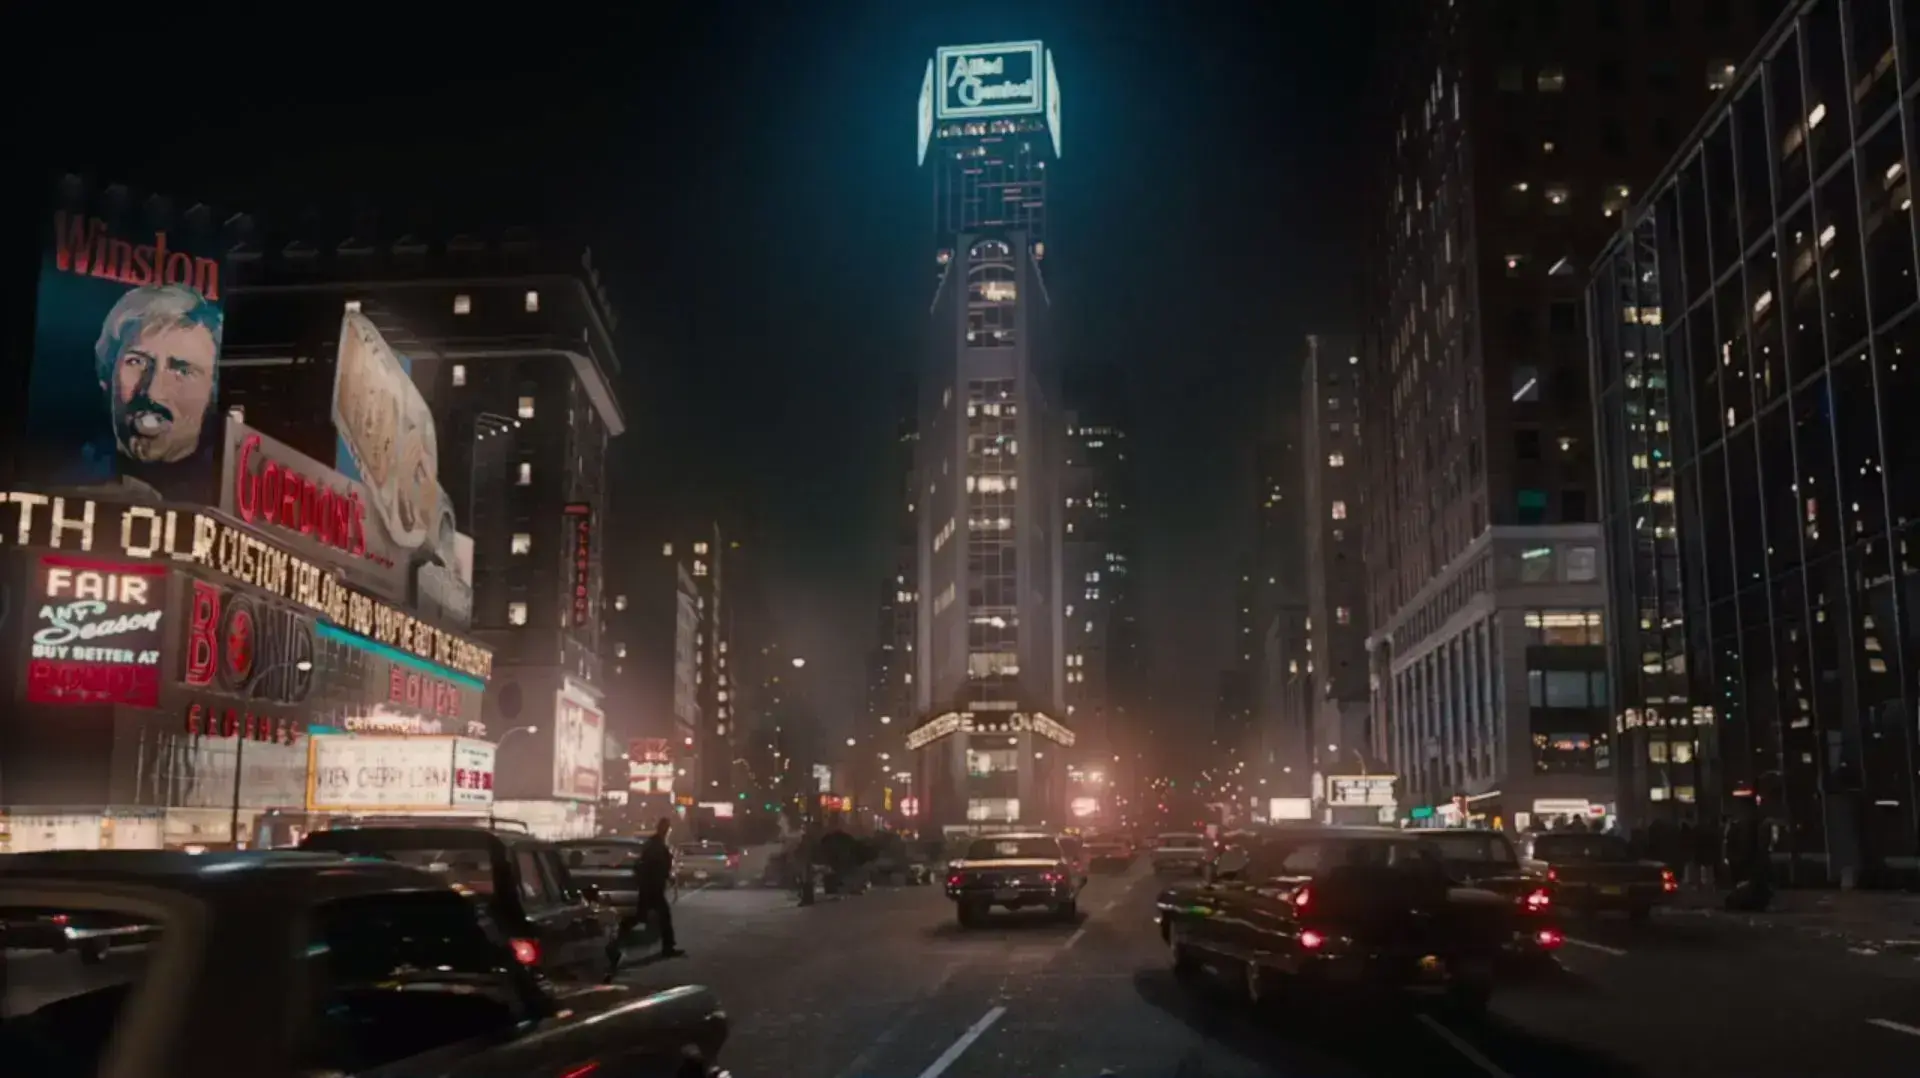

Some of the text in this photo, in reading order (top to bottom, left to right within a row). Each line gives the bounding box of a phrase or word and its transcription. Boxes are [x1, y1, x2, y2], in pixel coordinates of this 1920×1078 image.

[948, 56, 1003, 87] Allied
[958, 77, 1033, 106] Chemical
[54, 210, 219, 301] Winston
[121, 505, 216, 568] OUR
[219, 528, 288, 597] CUSTOM
[46, 567, 149, 606] FAIR
[32, 600, 163, 646] Season
[38, 604, 90, 622] ANY
[31, 645, 160, 665] BUY BETTER AT
